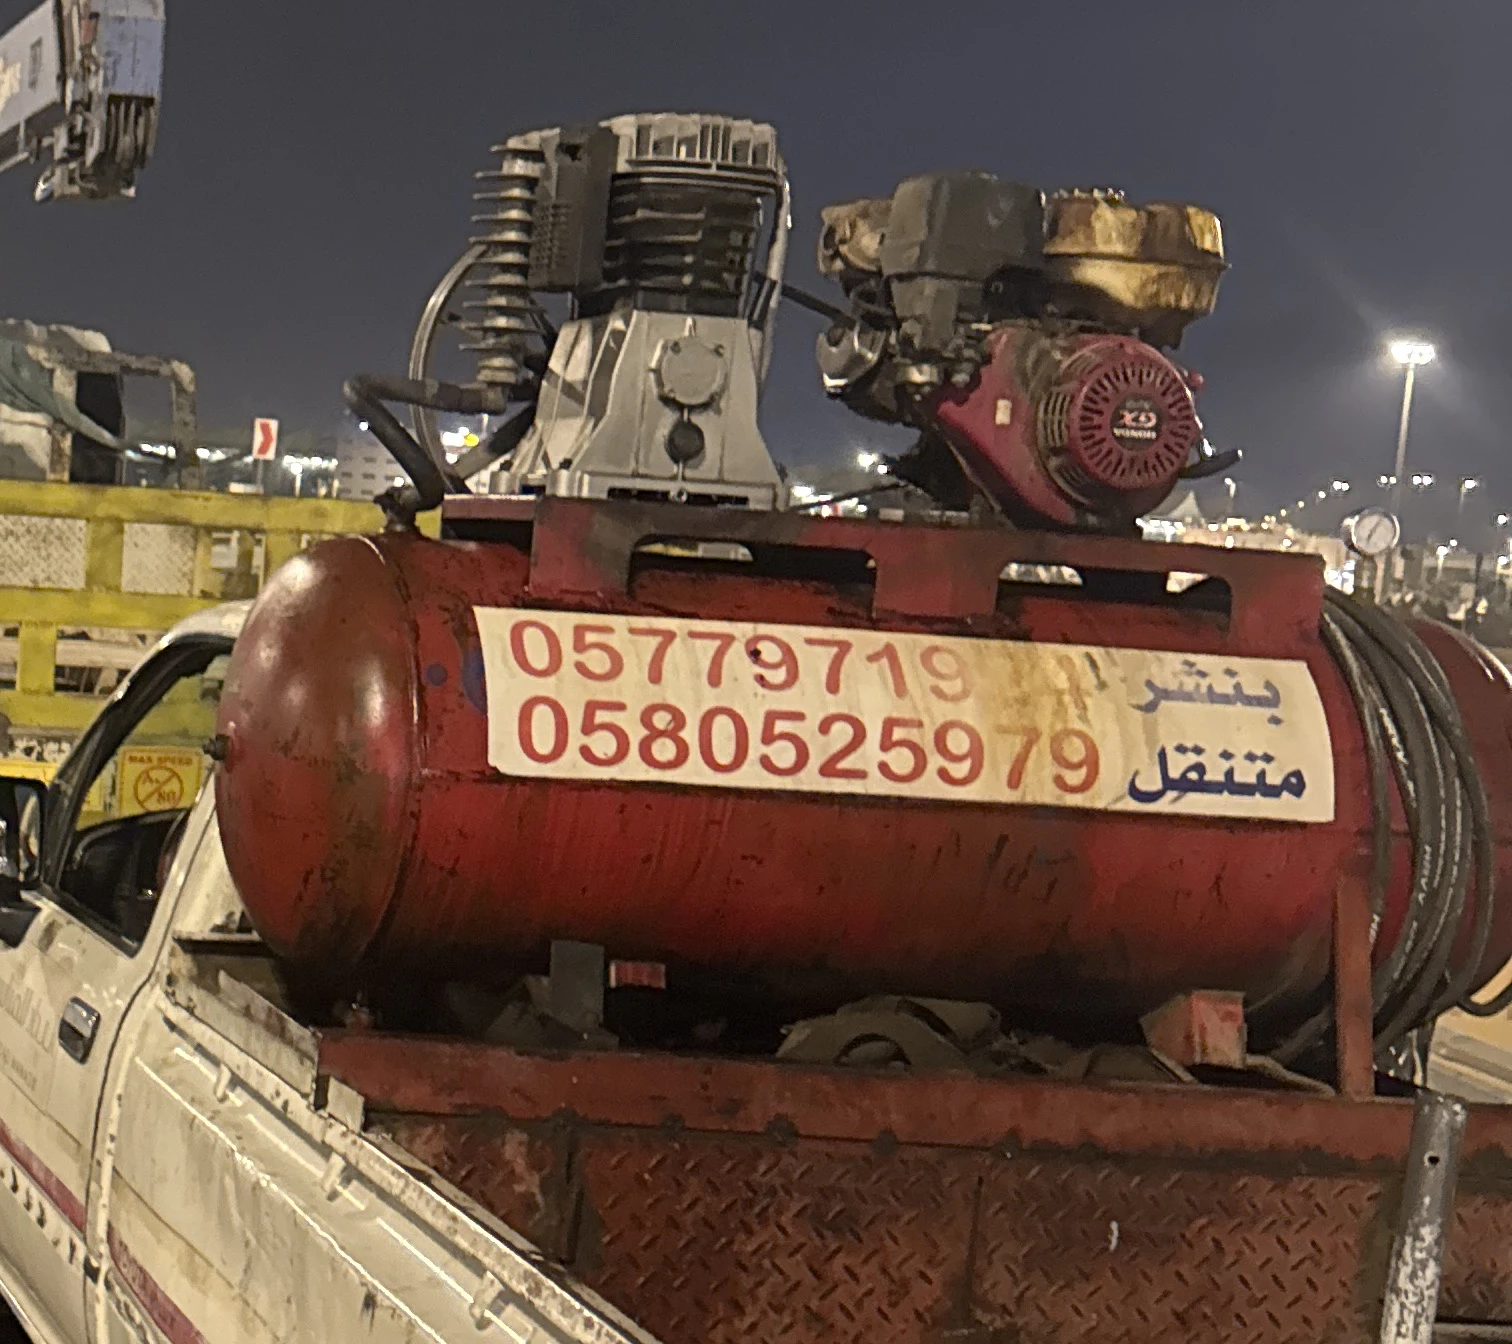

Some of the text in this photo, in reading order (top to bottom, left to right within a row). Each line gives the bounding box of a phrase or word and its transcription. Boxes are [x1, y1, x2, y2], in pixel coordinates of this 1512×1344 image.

[509, 618, 1088, 713] 05779719
[1129, 659, 1284, 725] بنشر
[516, 694, 1100, 795] 0580525979
[1127, 743, 1307, 804] متنقل
